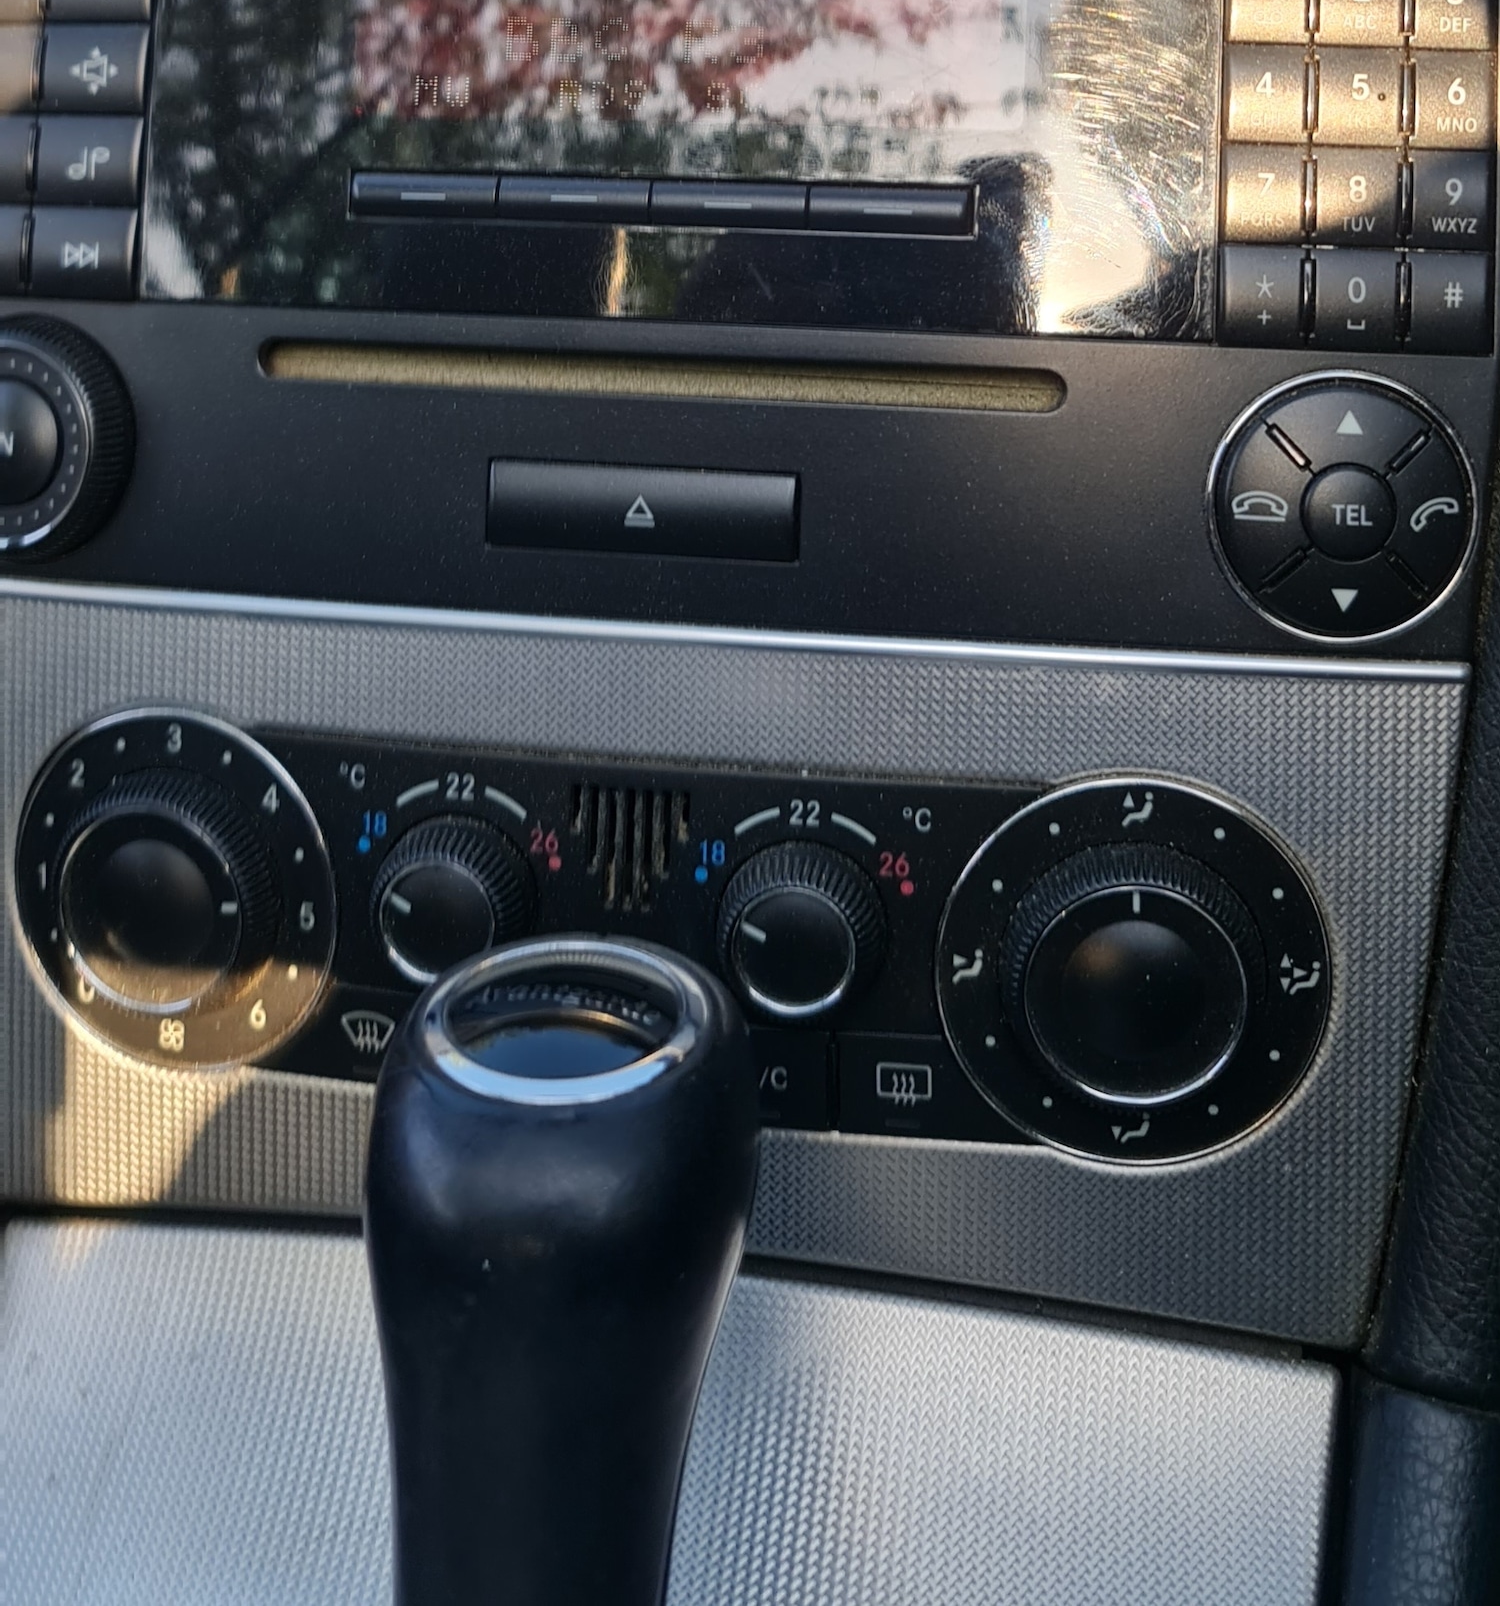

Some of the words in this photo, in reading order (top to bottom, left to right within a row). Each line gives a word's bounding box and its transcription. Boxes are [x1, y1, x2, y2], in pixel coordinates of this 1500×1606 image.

[1342, 14, 1377, 31] ABC
[1439, 16, 1472, 34] DEF
[505, 15, 629, 63] BBC
[414, 74, 470, 108] MW
[1256, 72, 1275, 97] 4
[1352, 74, 1370, 101] 5
[1447, 77, 1467, 105] 6
[1436, 117, 1478, 133] MNO
[1257, 173, 1276, 197] 7
[1349, 175, 1367, 203] 8
[1444, 178, 1463, 206] 9
[1240, 211, 1285, 227] PQRS
[1342, 216, 1376, 233] TUV
[1432, 217, 1478, 235] WXYZ
[1347, 276, 1366, 303] 0
[1331, 503, 1373, 527] TEL
[166, 722, 183, 755] 3
[69, 757, 86, 789] 2
[445, 771, 476, 802] 22
[262, 782, 281, 814] 4
[362, 809, 388, 838] 18
[788, 798, 821, 828] 22
[529, 826, 559, 855] 26
[700, 837, 726, 867] 18
[38, 860, 48, 892] 1
[878, 851, 911, 878] 26
[300, 901, 316, 932] 5
[249, 998, 267, 1030] 6
[758, 1065, 788, 1091] /C
